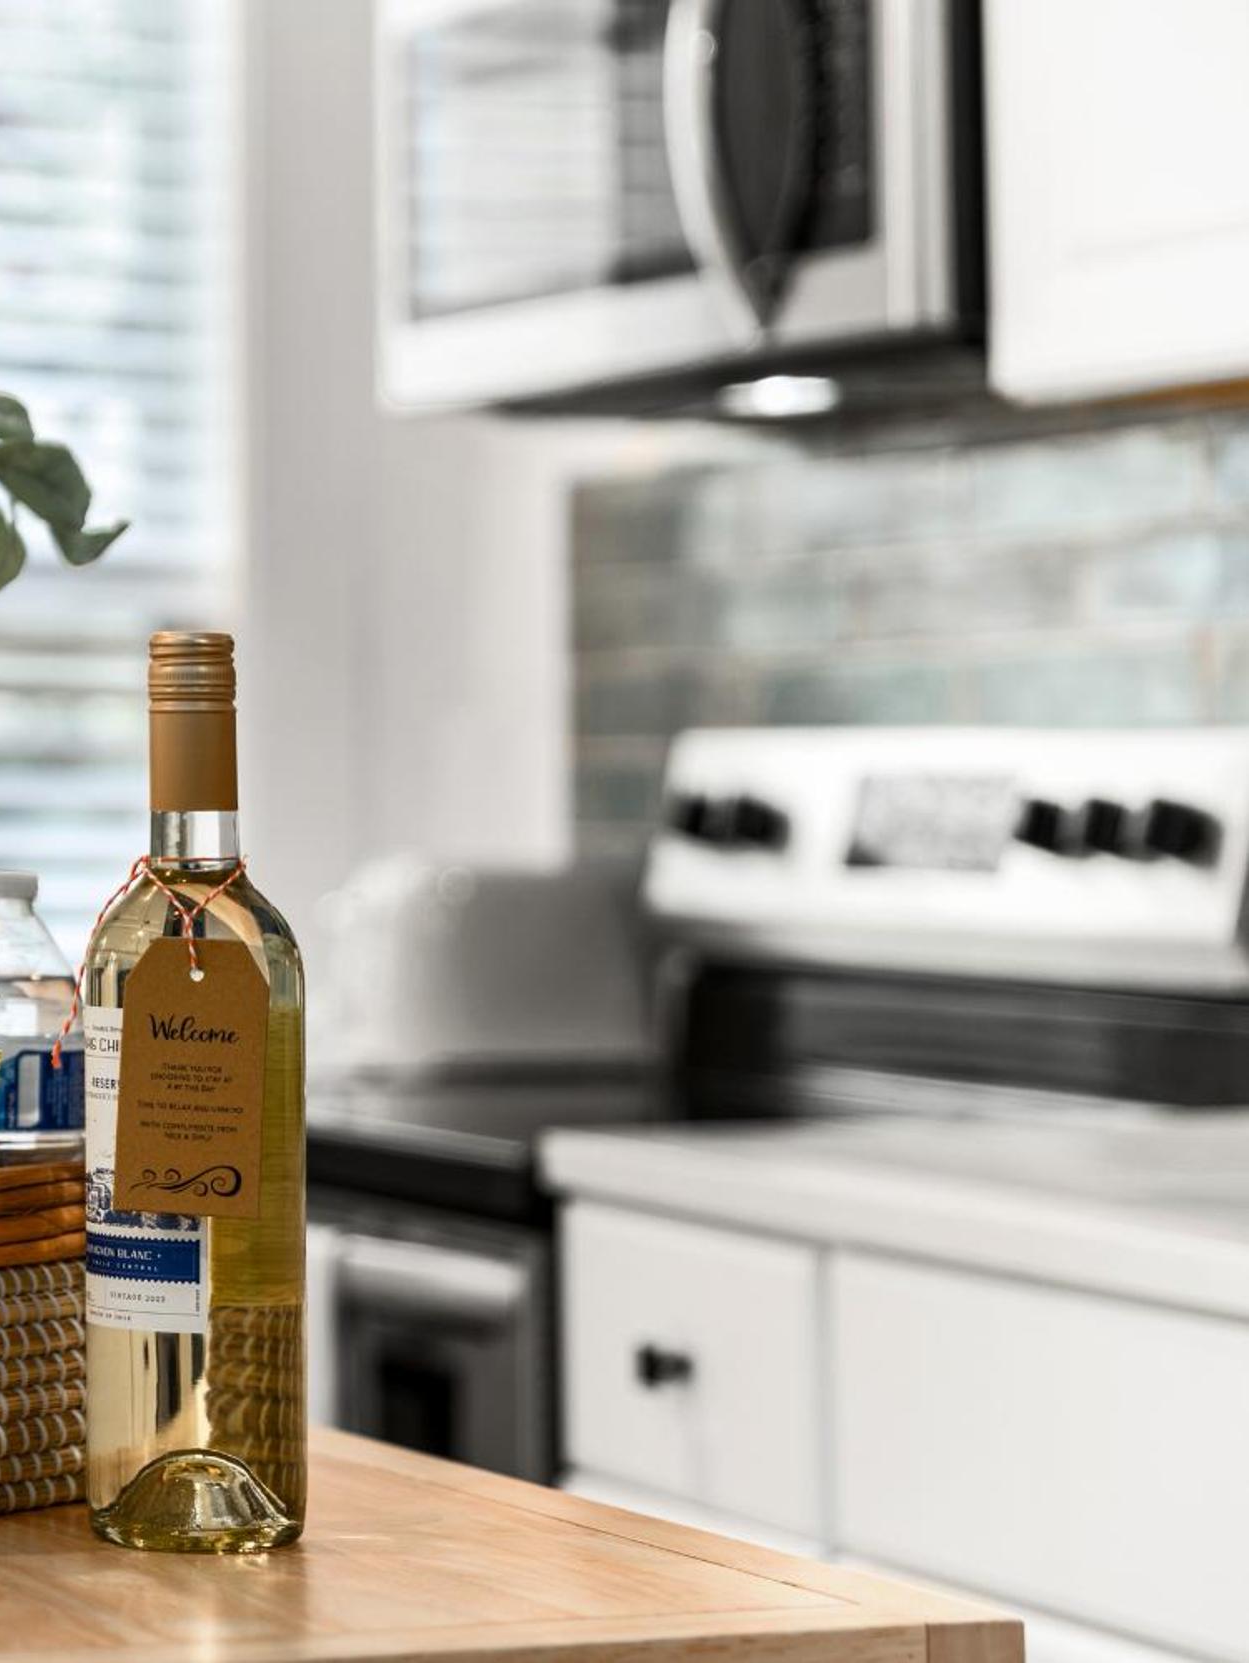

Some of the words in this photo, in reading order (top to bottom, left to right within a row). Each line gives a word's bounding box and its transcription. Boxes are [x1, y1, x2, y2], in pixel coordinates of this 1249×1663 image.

[149, 1012, 240, 1044] Welcome
[162, 1062, 188, 1072] THANK
[190, 1065, 204, 1073] YOU
[205, 1065, 222, 1074] FOR
[150, 1072, 191, 1082] CHOOSING
[193, 1074, 204, 1083] TO
[206, 1075, 222, 1083] STAY
[156, 1101, 167, 1110] TO
[169, 1102, 192, 1111] RELAX
[140, 1120, 161, 1129] WITH
[163, 1122, 214, 1133] COMPLIMENTS
[216, 1125, 238, 1134] FROM
[117, 1248, 153, 1262] BLANC
[110, 1291, 142, 1303] VINTAGE
